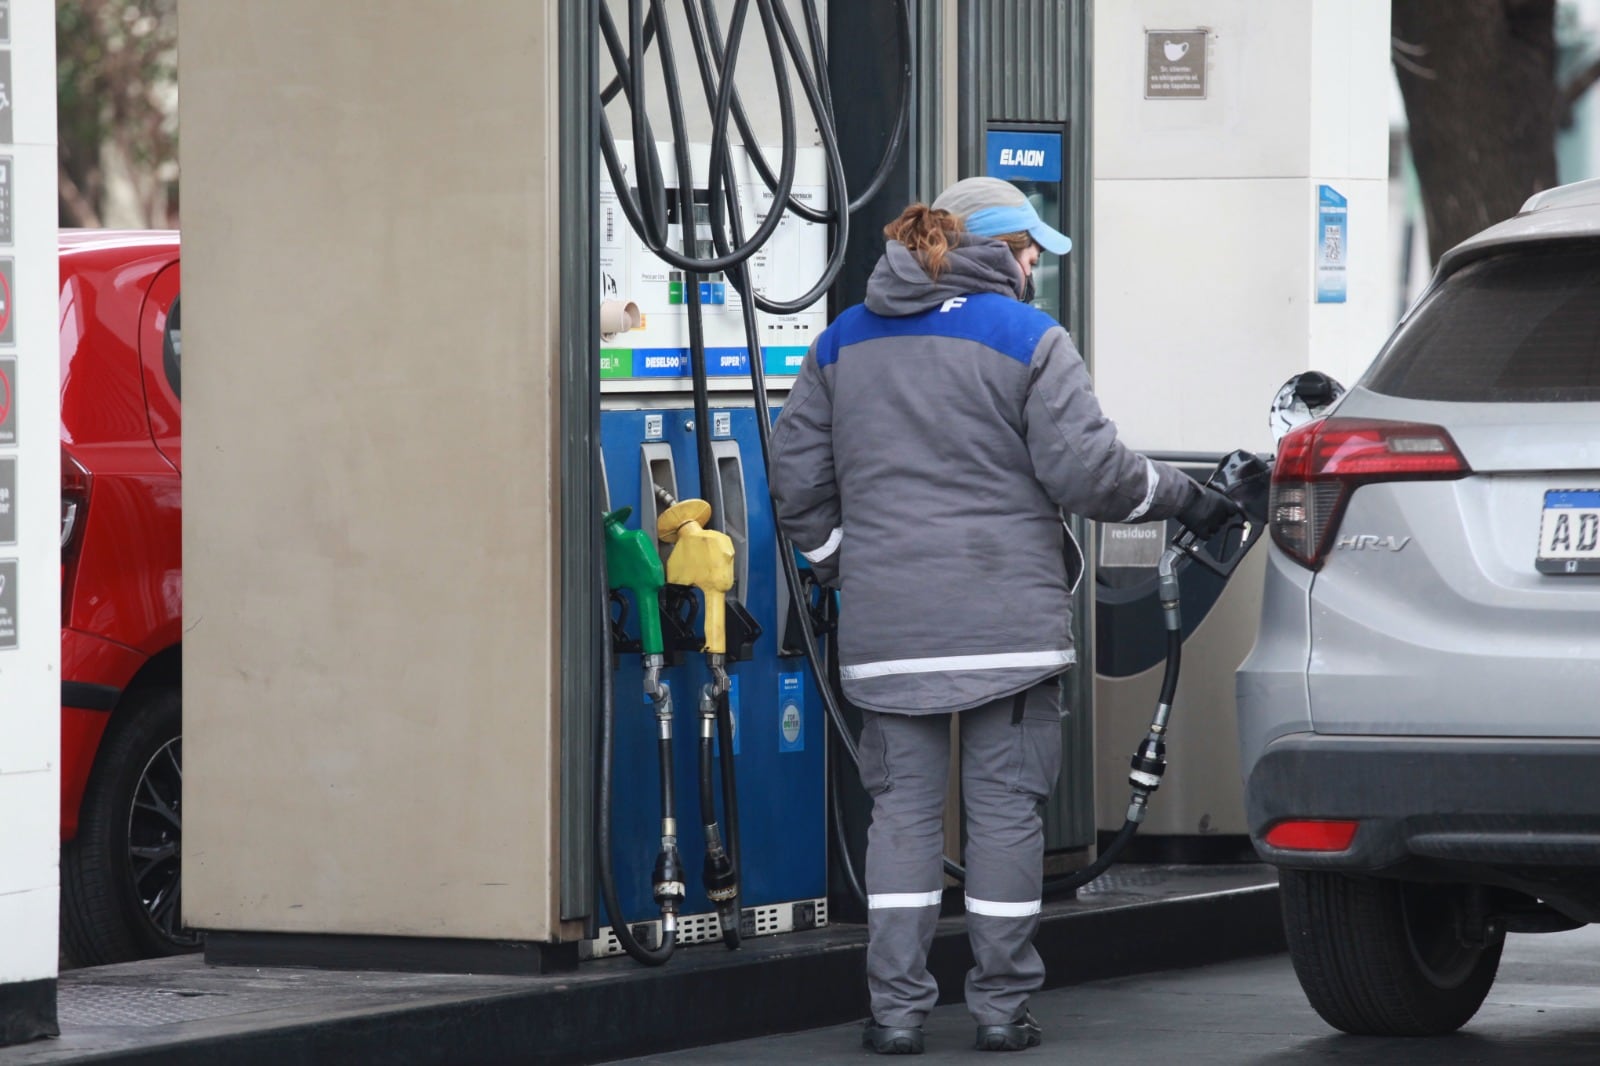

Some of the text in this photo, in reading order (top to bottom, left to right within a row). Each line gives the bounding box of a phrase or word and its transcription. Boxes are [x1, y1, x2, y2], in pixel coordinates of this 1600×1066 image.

[1000, 148, 1045, 167] ELAION
[720, 355, 740, 367] SUPER
[1111, 526, 1158, 539] residuos
[1550, 513, 1599, 551] AD
[1337, 534, 1411, 552] HR-V
